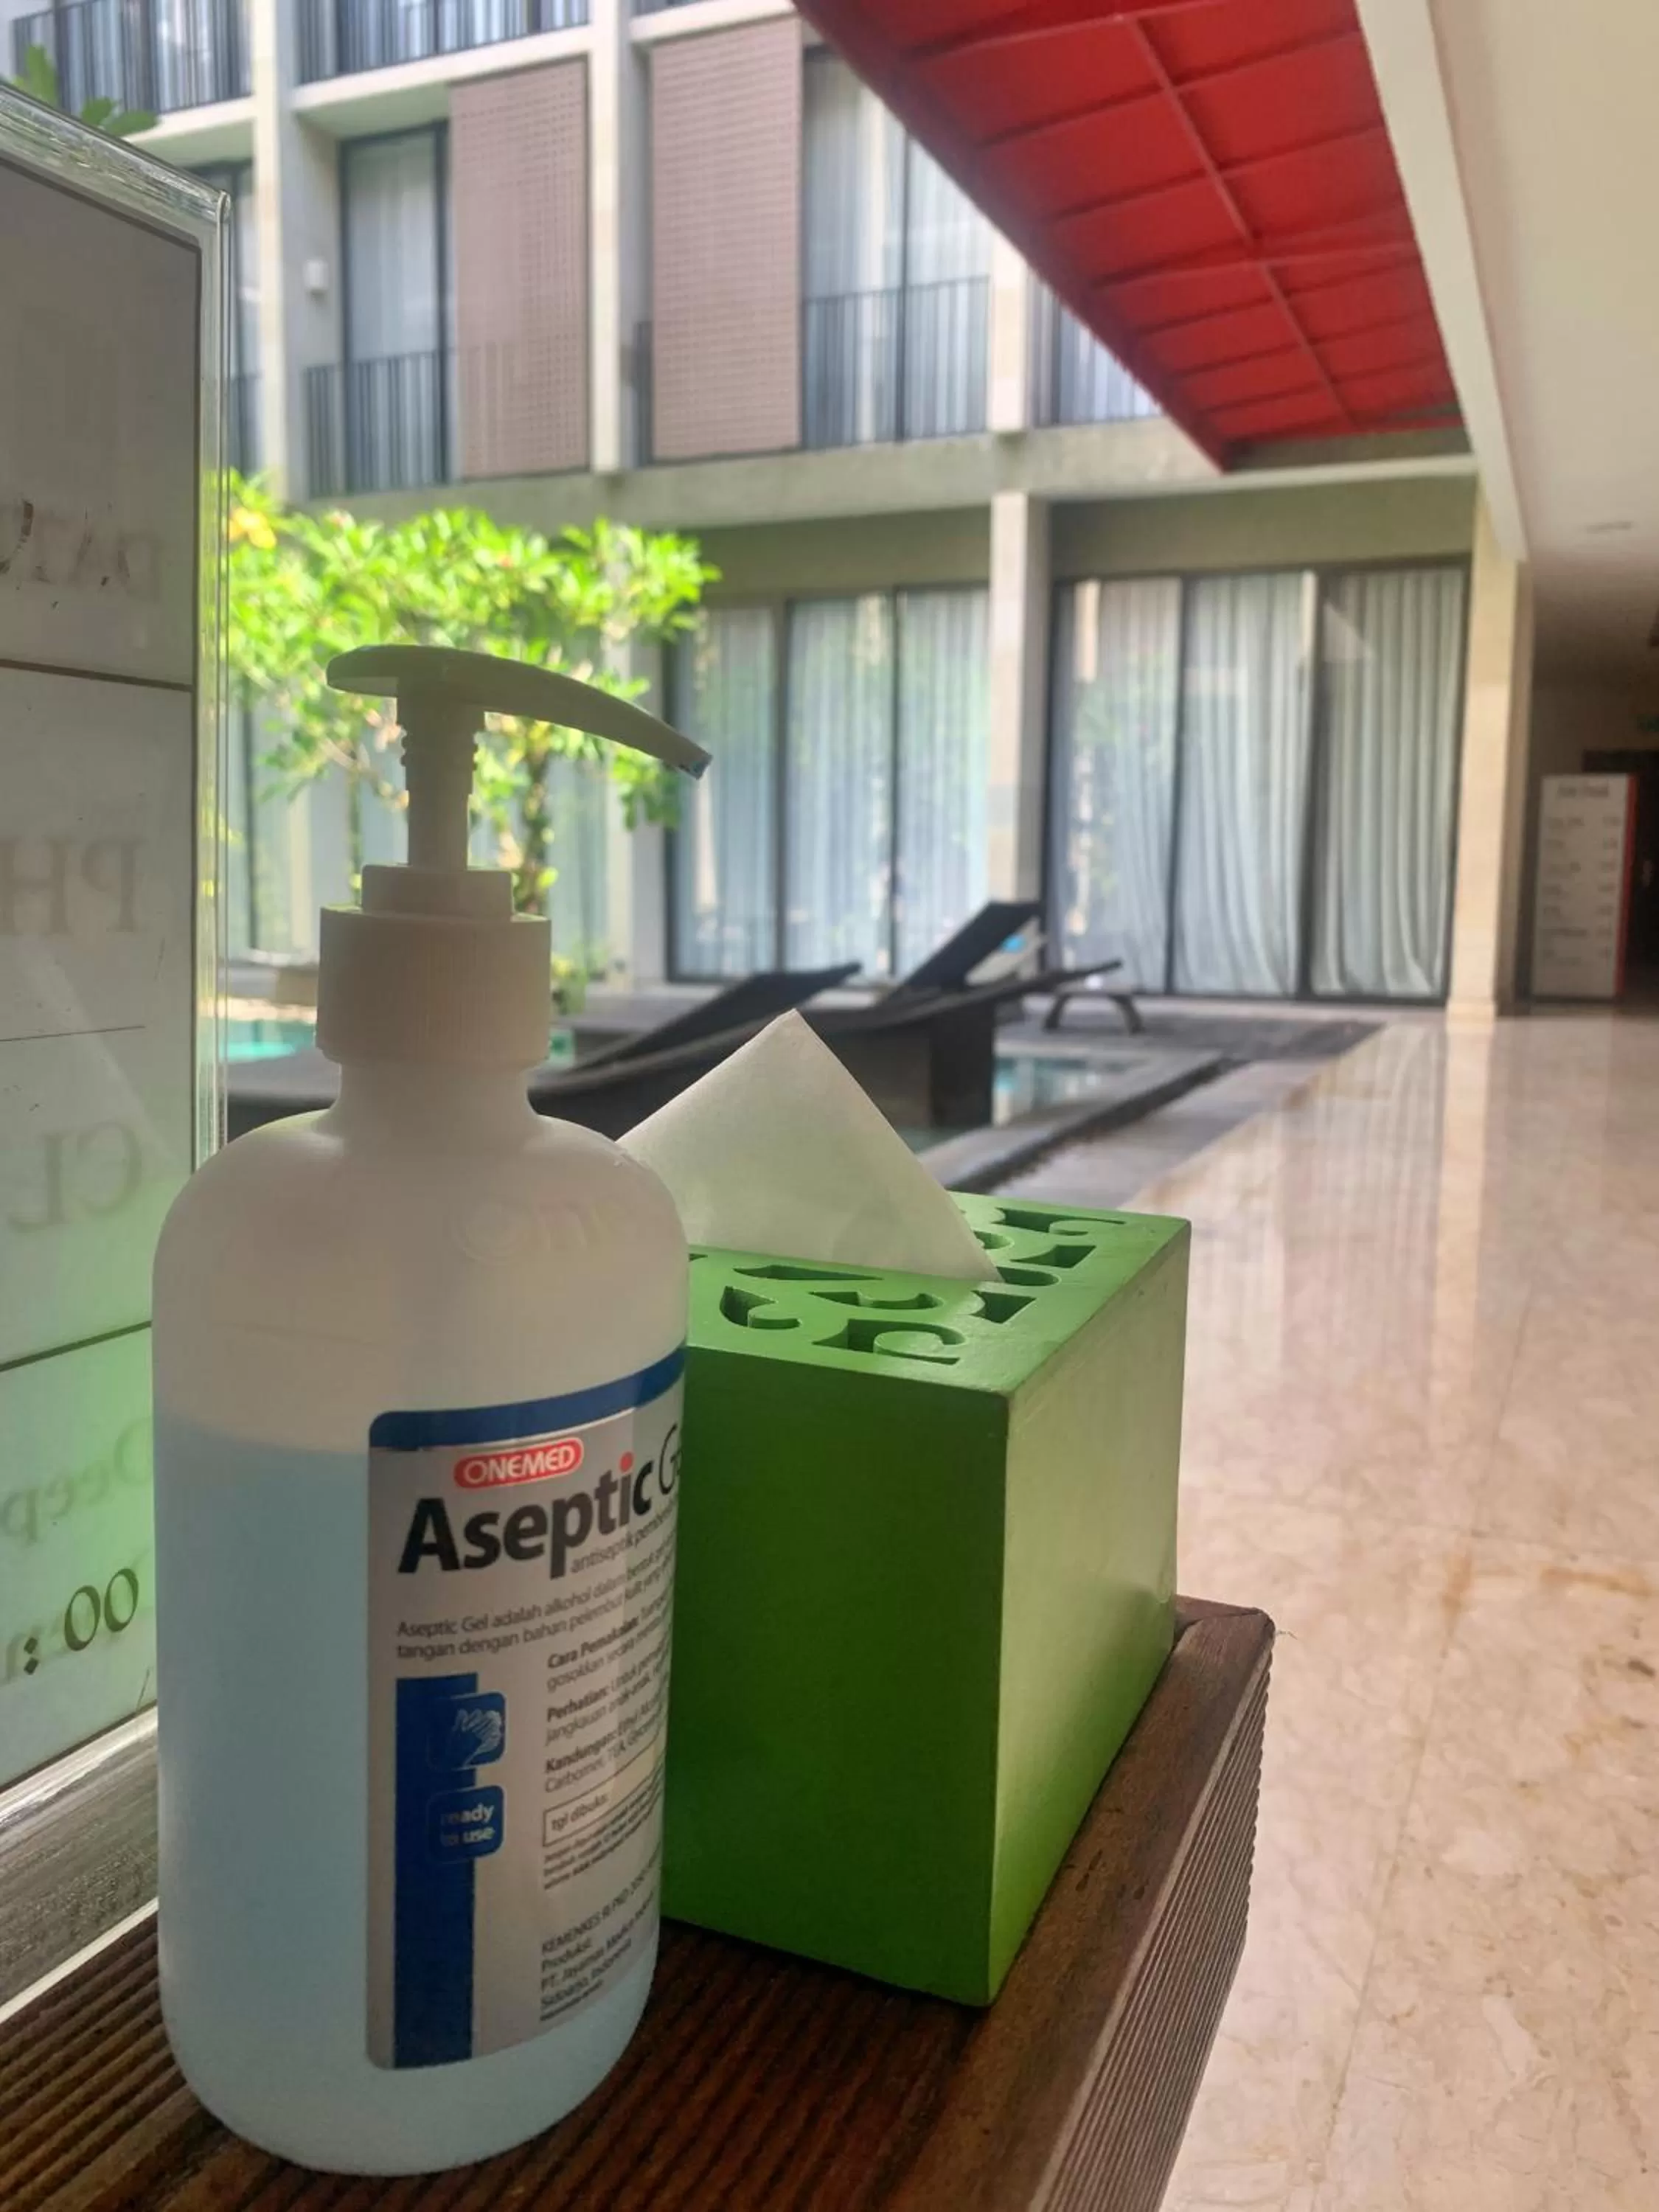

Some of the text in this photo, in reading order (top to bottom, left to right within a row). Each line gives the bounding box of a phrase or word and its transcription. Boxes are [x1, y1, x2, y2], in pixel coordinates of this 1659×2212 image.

[463, 1444, 575, 1484] ONEMED
[397, 1450, 653, 1581] Aseptic
[462, 1613, 489, 1632] Gel
[397, 1642, 455, 1662] tangan
[459, 1632, 519, 1653] dengan
